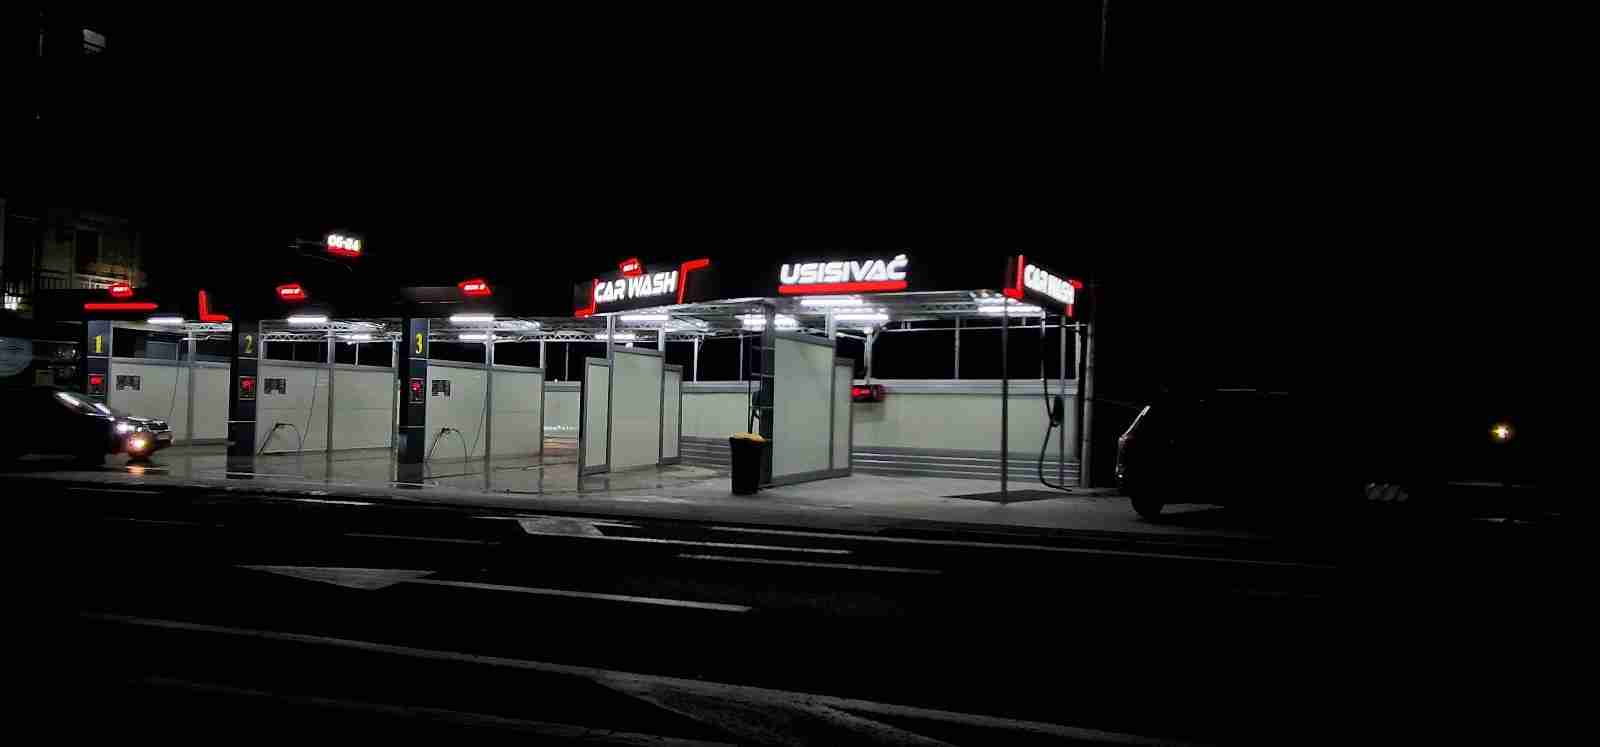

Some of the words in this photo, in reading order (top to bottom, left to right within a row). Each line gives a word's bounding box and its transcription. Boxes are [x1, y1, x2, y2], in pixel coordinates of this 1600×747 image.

[780, 254, 908, 284] USISIVAČ
[594, 279, 626, 304] CAR
[628, 270, 678, 299] WASH
[244, 335, 253, 353] 2
[414, 333, 424, 353] 3
